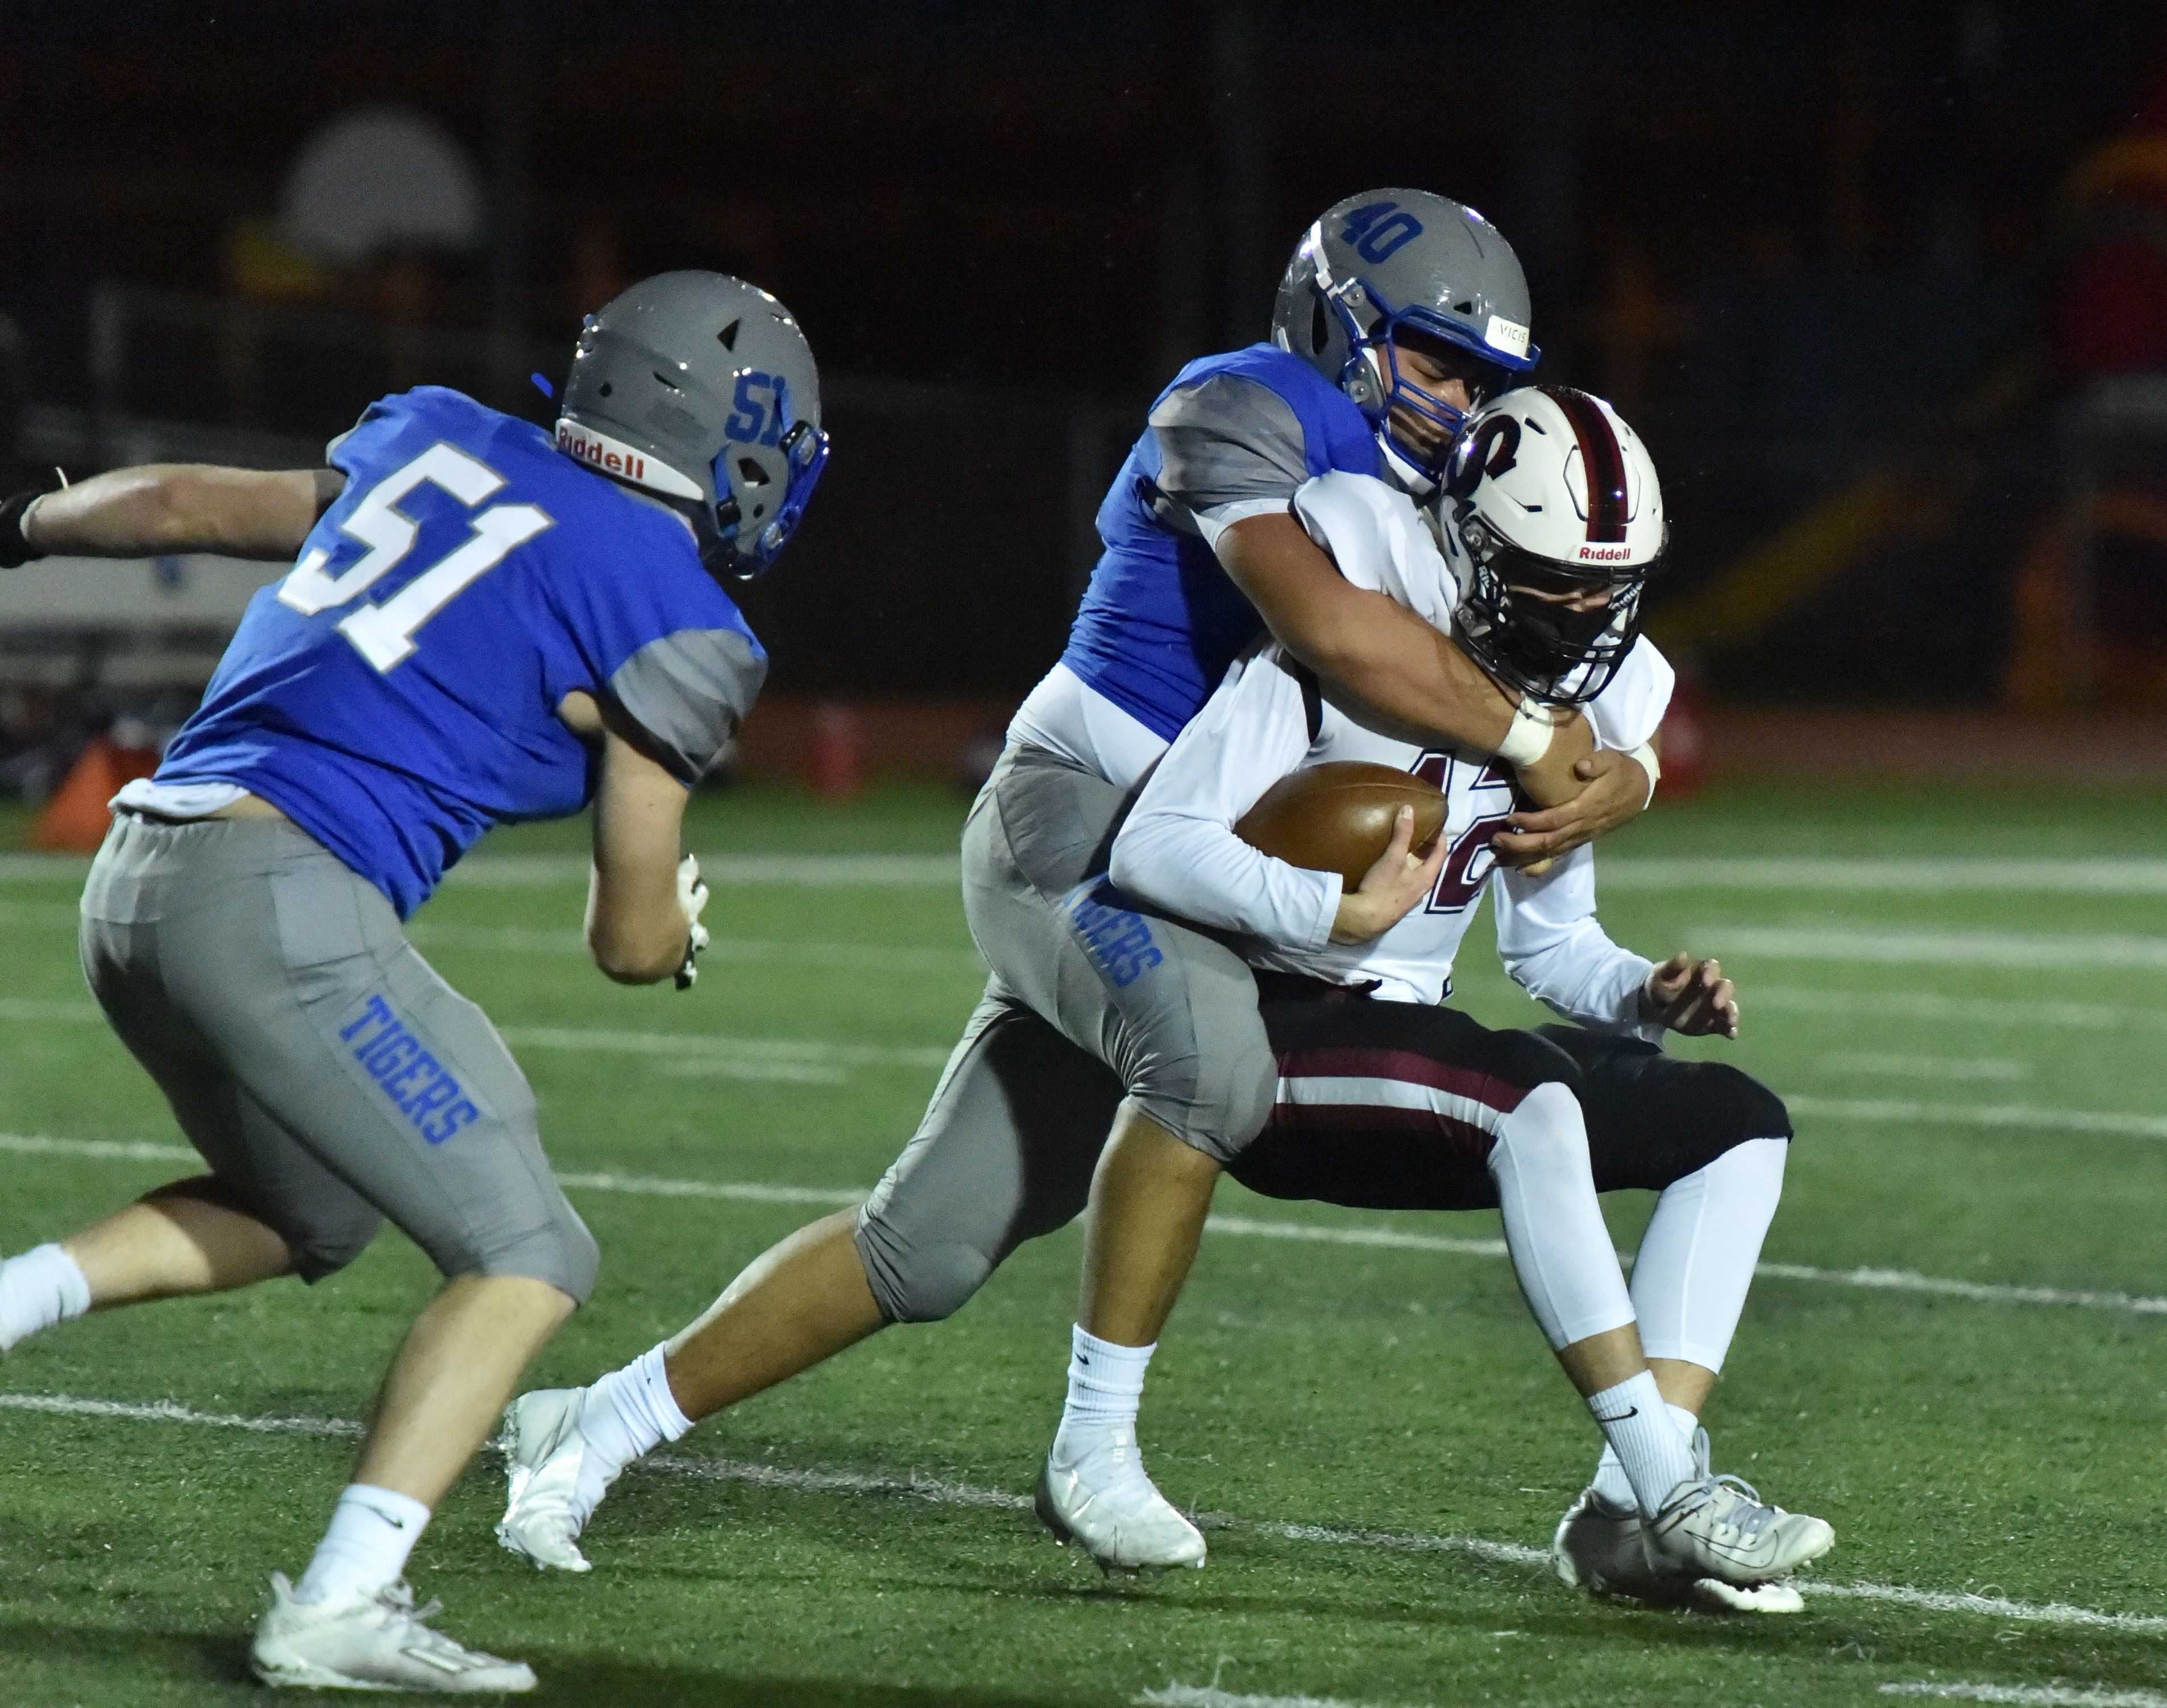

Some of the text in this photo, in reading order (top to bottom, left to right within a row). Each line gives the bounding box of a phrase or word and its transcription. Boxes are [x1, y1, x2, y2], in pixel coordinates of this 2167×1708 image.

[1339, 201, 1423, 265] 40
[1500, 323, 1527, 343] VICIS
[724, 370, 786, 448] 51
[558, 426, 645, 479] Riddell
[277, 441, 557, 674] 51
[1579, 547, 1632, 561] Riddell
[339, 994, 480, 1145] TIGERS
